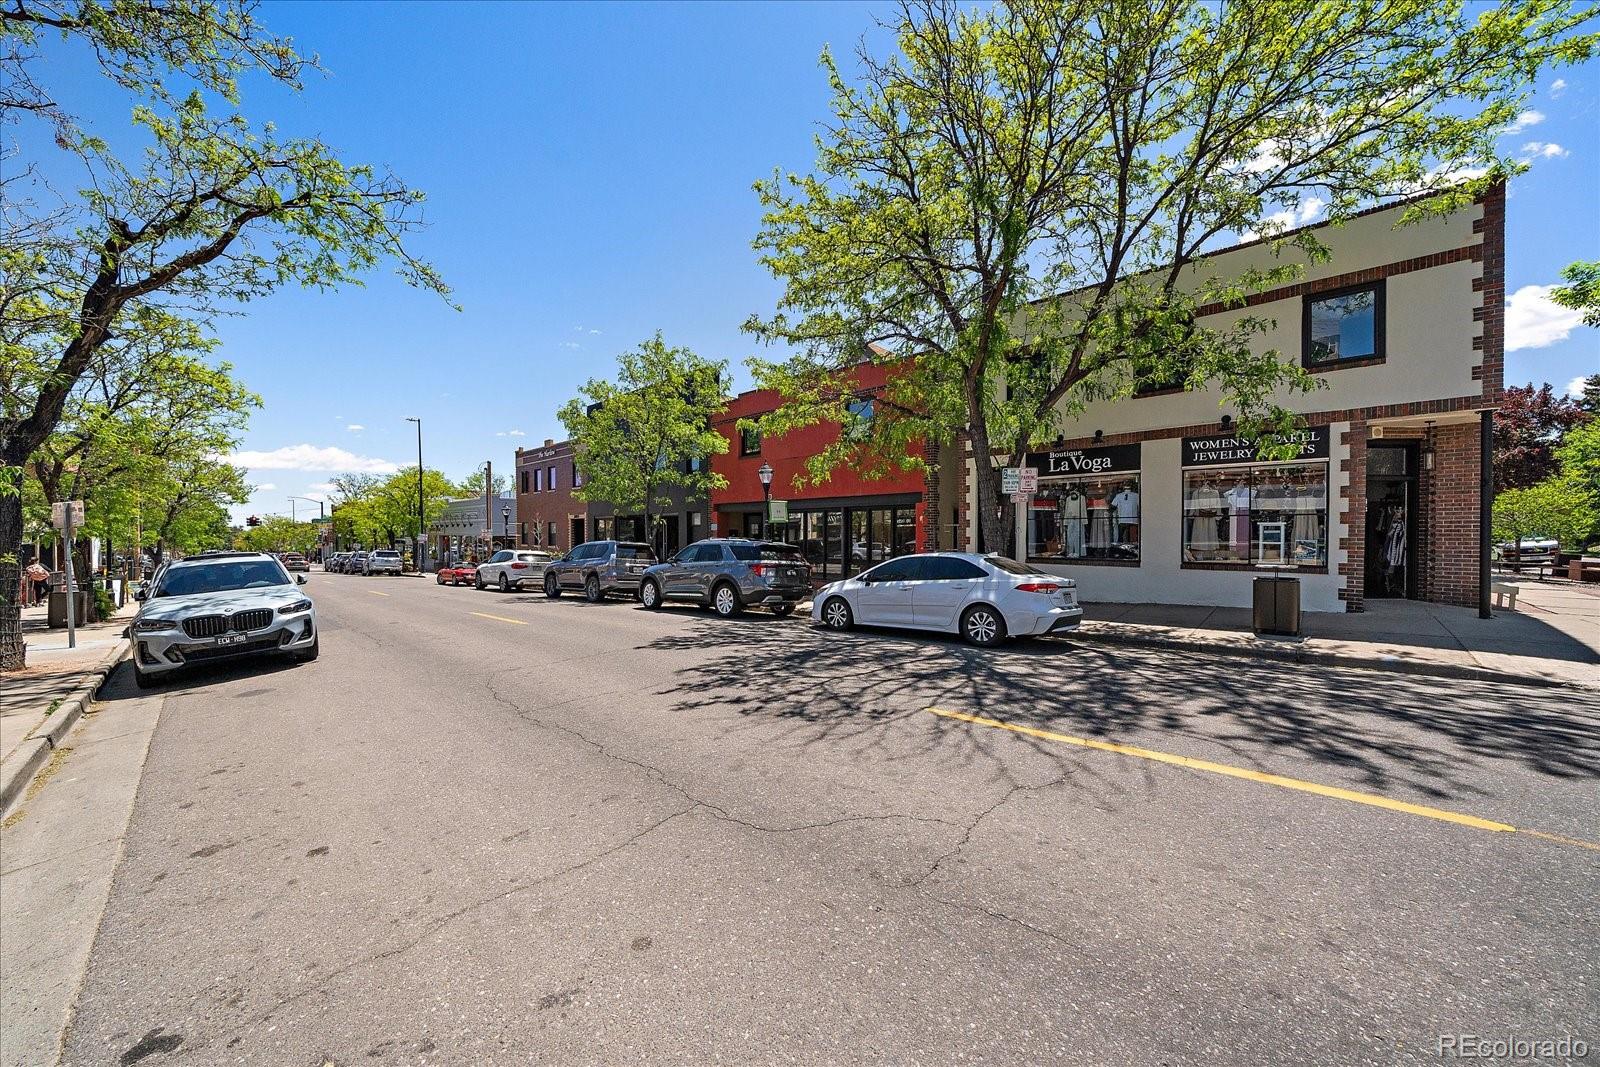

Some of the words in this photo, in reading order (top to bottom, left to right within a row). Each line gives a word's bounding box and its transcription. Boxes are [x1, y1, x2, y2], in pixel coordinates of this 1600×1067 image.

[1190, 437, 1250, 450] WOMEN'S
[1254, 431, 1321, 448] APAREL
[1049, 450, 1083, 459] Boutique
[1192, 448, 1254, 462] JEWELRY
[1070, 455, 1113, 472] Voga
